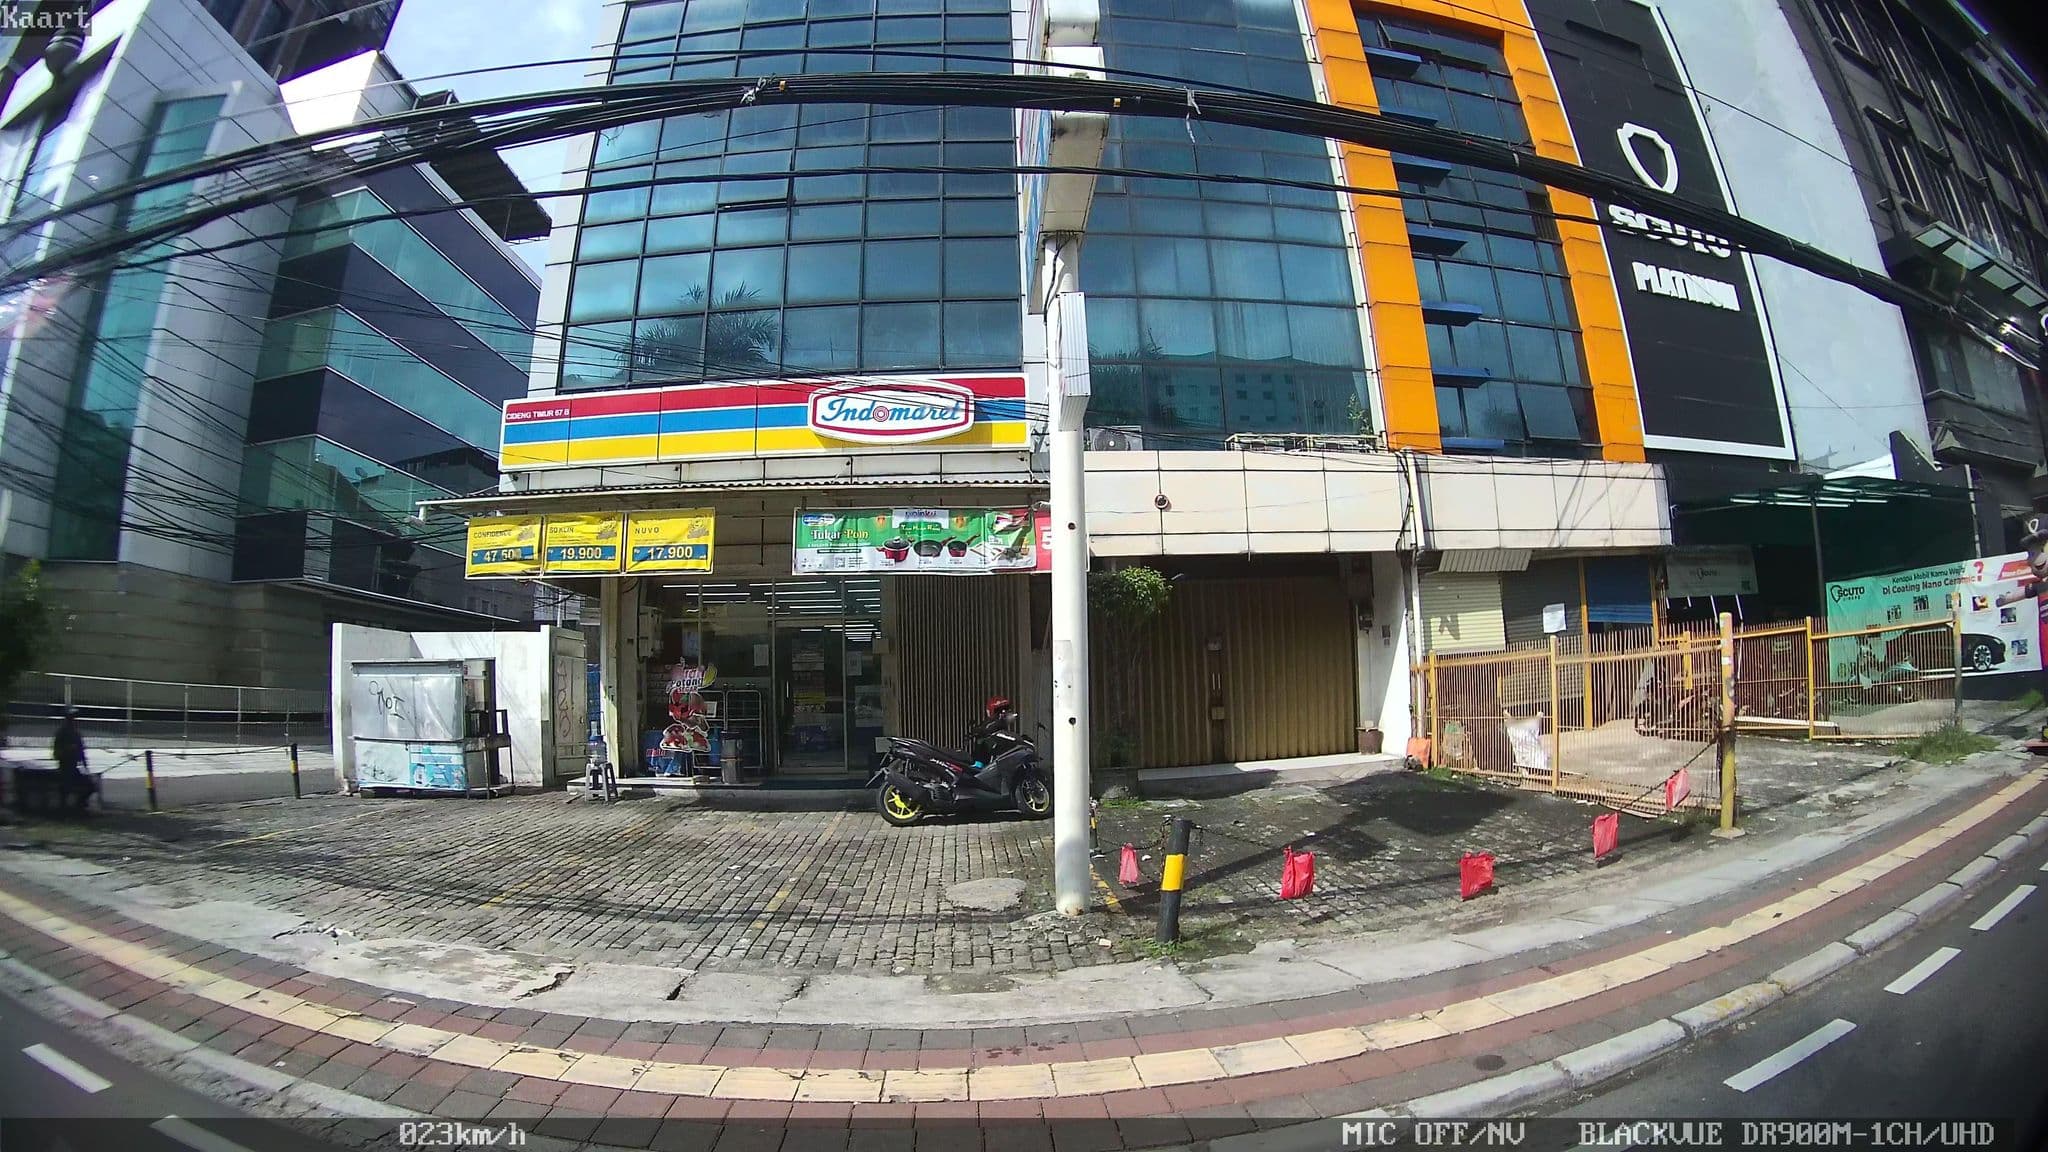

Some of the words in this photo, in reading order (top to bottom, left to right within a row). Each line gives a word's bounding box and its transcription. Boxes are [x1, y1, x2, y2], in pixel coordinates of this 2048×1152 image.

[506, 411, 532, 420] CIDENG
[532, 409, 554, 418] TIMUR
[821, 397, 961, 422] Indomaret
[634, 526, 660, 535] NUVO
[810, 529, 841, 542] Tukar
[844, 528, 869, 539] Poin
[483, 549, 521, 562] 4750
[560, 547, 602, 560] 19.900
[647, 545, 693, 560] 17.900
[1837, 586, 1865, 598] SCUTO
[1892, 583, 1920, 593] Coating
[1922, 579, 1942, 590] Nano
